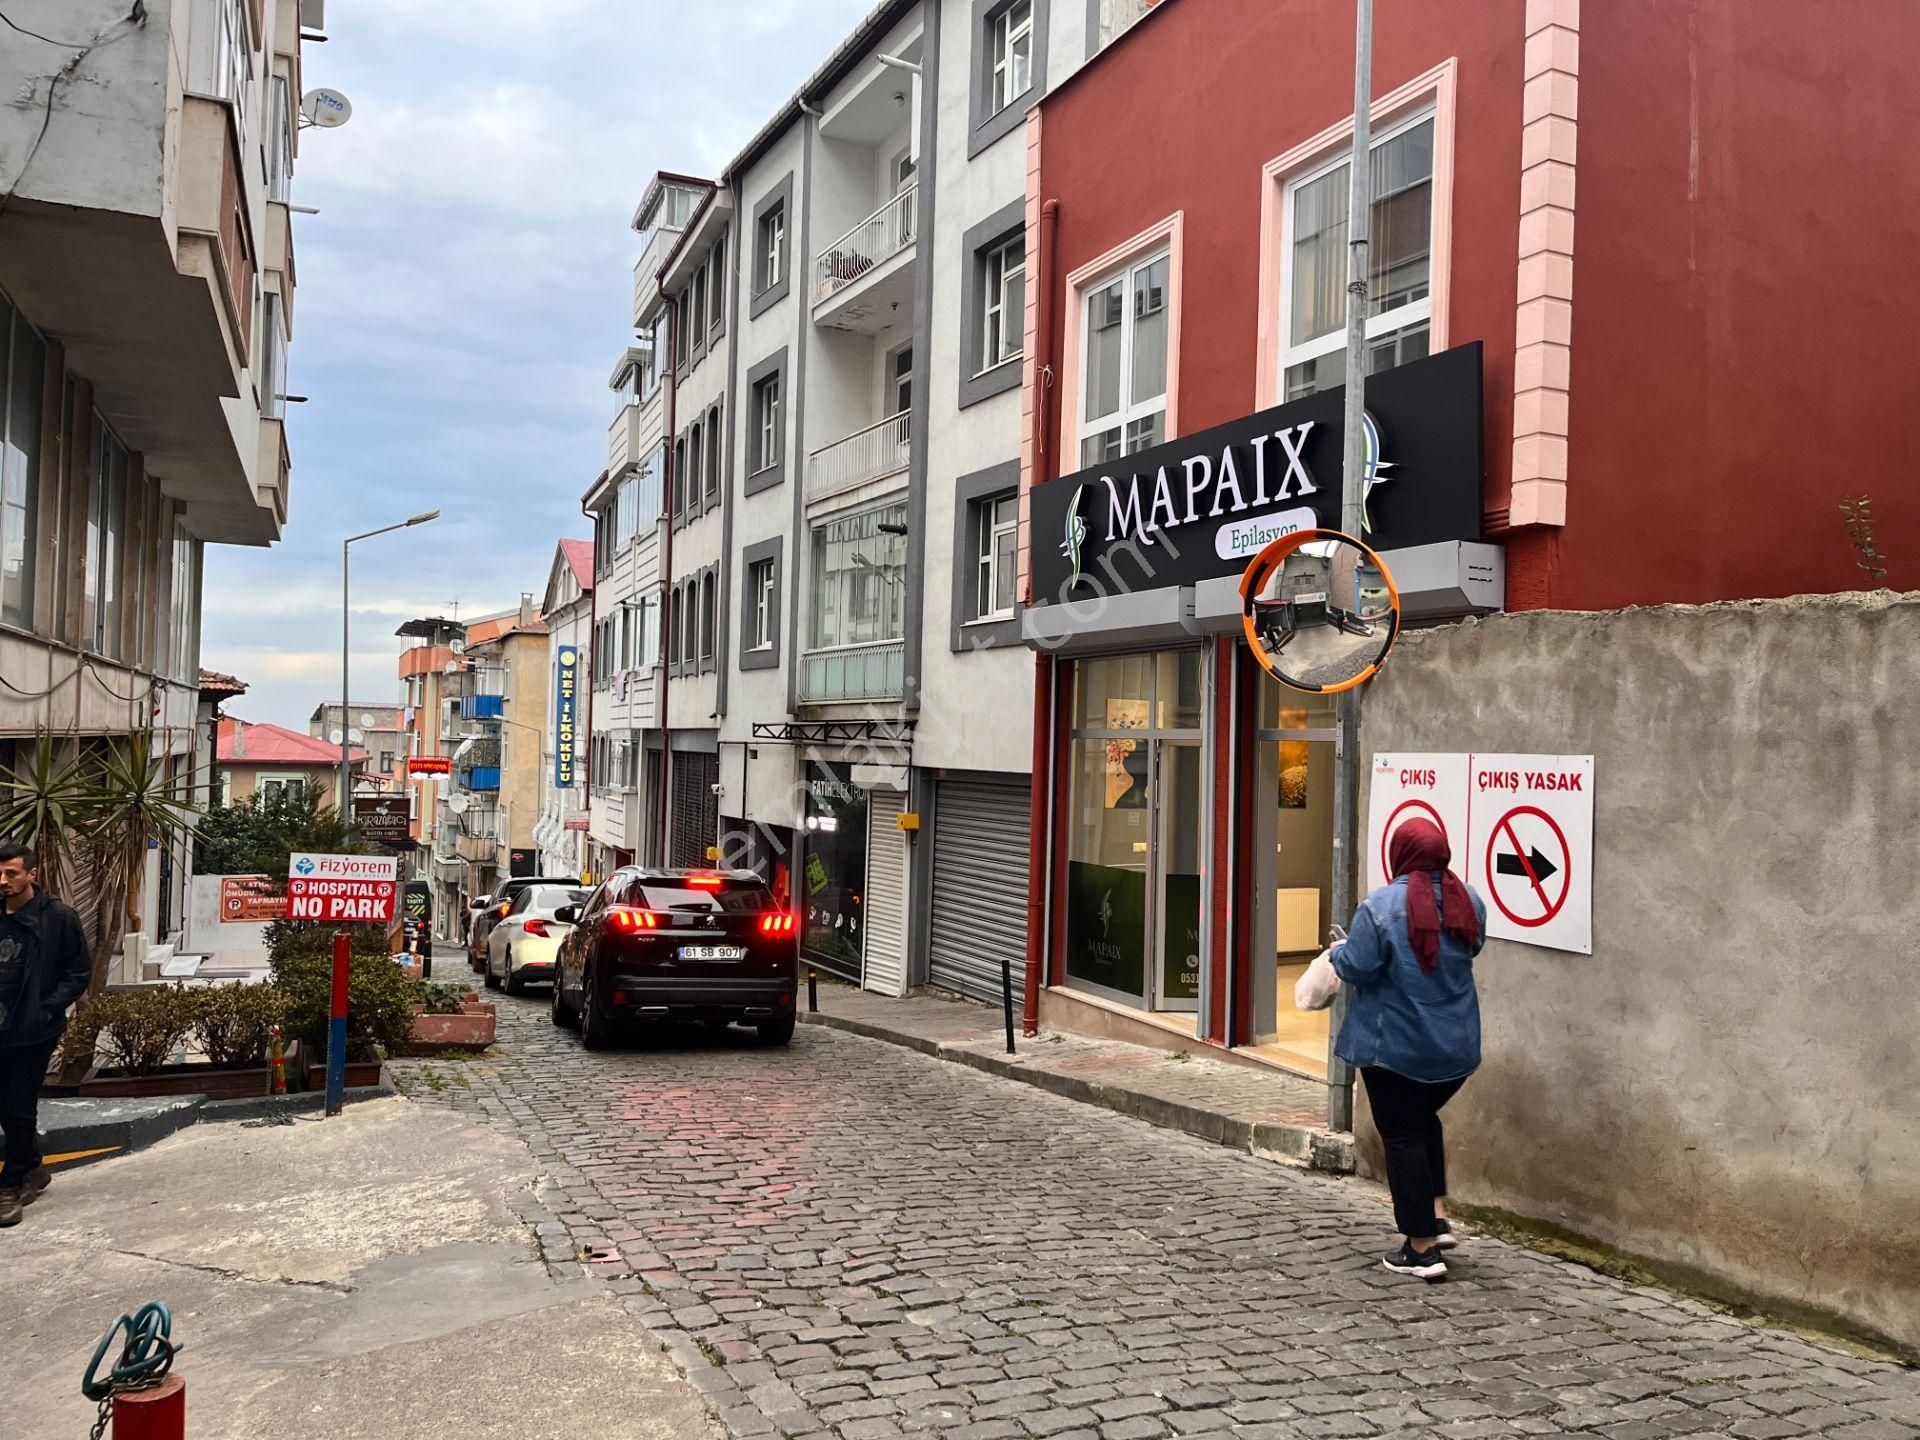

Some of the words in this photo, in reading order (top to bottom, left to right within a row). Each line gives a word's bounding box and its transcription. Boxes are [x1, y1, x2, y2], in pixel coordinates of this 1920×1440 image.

[1100, 420, 1317, 547] MAPAIX
[1400, 768, 1436, 790] ÇIKIŞ
[1478, 771, 1520, 793] ÇIKIŞ
[1524, 772, 1583, 791] YASAK
[308, 881, 376, 897] HOSPITAL
[292, 896, 323, 918] NO
[330, 897, 388, 919] PARK
[685, 947, 696, 957] 61
[700, 947, 714, 957] SB
[718, 947, 739, 957] 907
